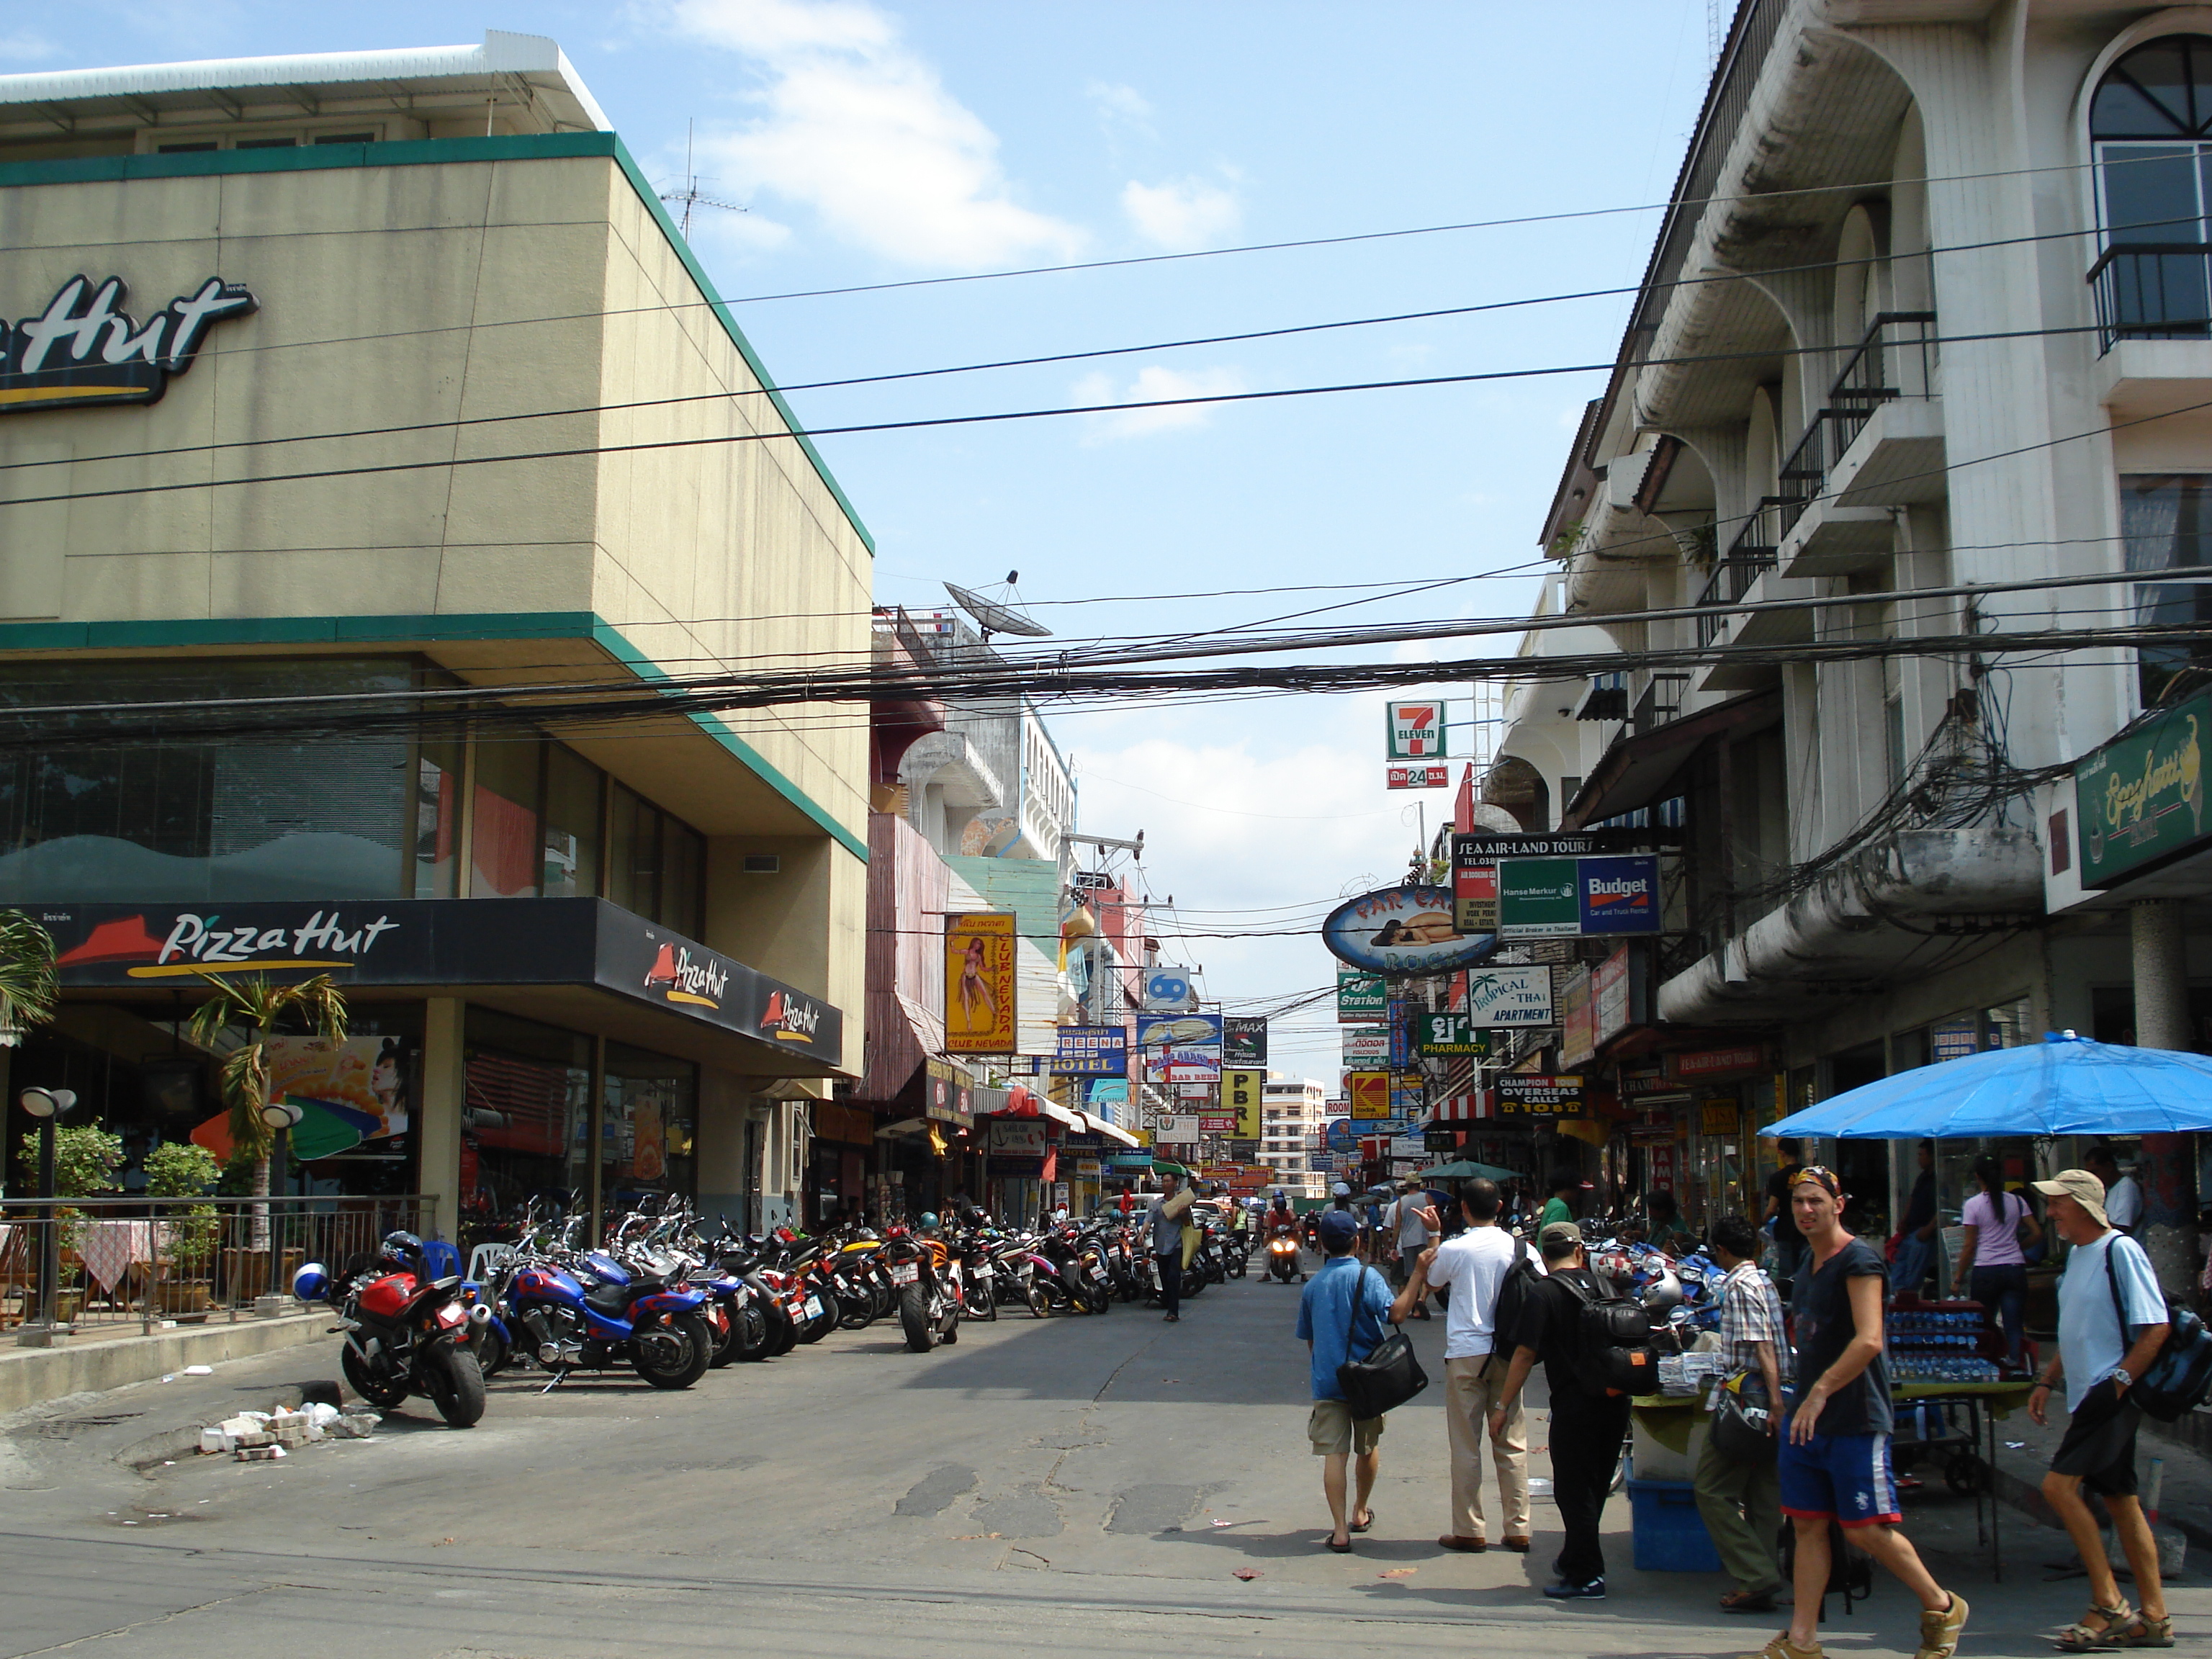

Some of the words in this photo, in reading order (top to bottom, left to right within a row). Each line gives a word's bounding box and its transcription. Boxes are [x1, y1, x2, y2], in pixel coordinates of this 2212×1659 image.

[1408, 770, 1426, 783] 24
[1552, 840, 1593, 853] TOURS
[1588, 878, 1647, 897] Budget
[1355, 892, 1403, 920] FAR
[1414, 889, 1452, 912] EA
[158, 913, 287, 964] Pizza
[293, 909, 401, 956] Hut
[999, 932, 1011, 972] CLUB
[675, 947, 705, 994] Pizza
[705, 958, 729, 999] Hut
[1473, 979, 1529, 1012] TROPICAL
[999, 975, 1011, 1034] NEVADA
[781, 993, 803, 1032] Pizza
[802, 1001, 819, 1034] Hut
[1493, 1009, 1551, 1022] APARTMENT
[948, 1039, 973, 1048] CLUB
[975, 1039, 1013, 1048] NEVADA
[1423, 1044, 1486, 1053] PHARMACY
[1151, 1053, 1175, 1073] LAST
[1499, 1079, 1549, 1087] CHAMPION
[1555, 1079, 1579, 1087] TOUR
[1501, 1087, 1579, 1096] OVERSEAS
[1521, 1103, 1550, 1113] 10
[1177, 1121, 1196, 1130] THE
[1158, 1133, 1197, 1142] THISTLE
